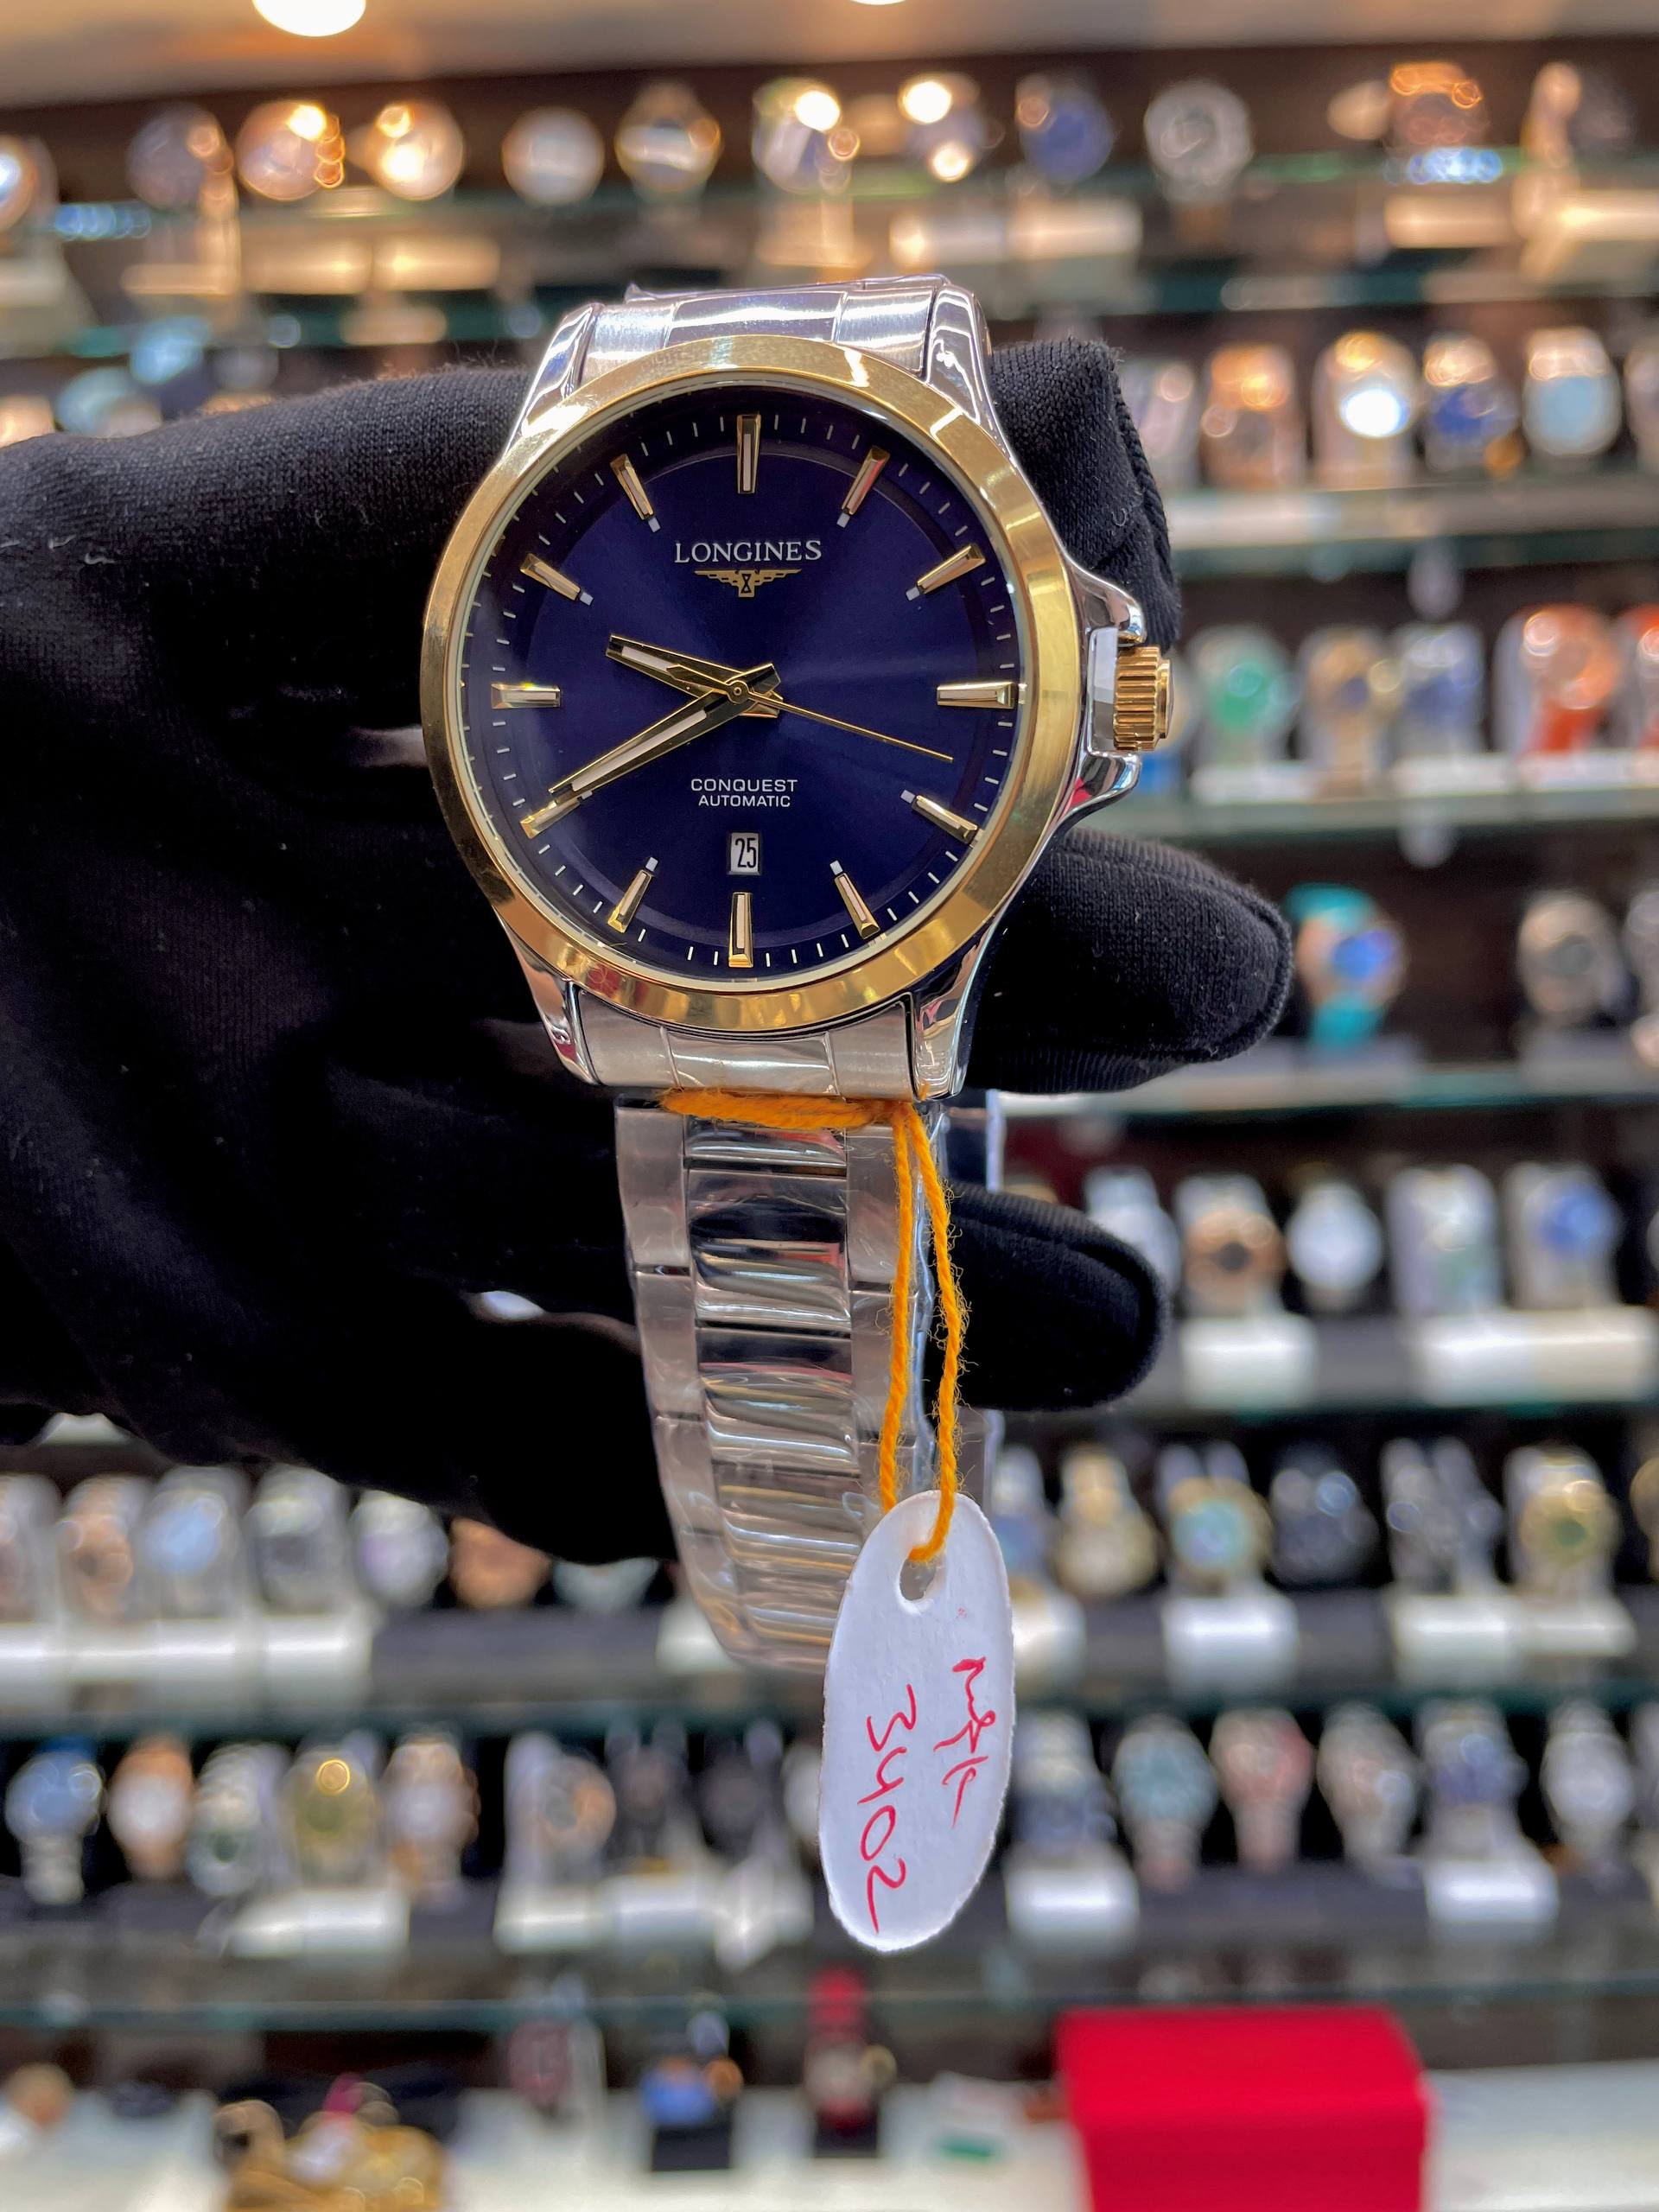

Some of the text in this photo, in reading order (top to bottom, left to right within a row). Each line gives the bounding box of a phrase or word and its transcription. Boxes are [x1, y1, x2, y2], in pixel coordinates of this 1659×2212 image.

[675, 540, 822, 563] LONGINES
[691, 779, 798, 791] CONQUEST
[698, 795, 791, 807] AUTOMATIC
[735, 837, 757, 868] 25
[857, 1683, 917, 1934] 3402
